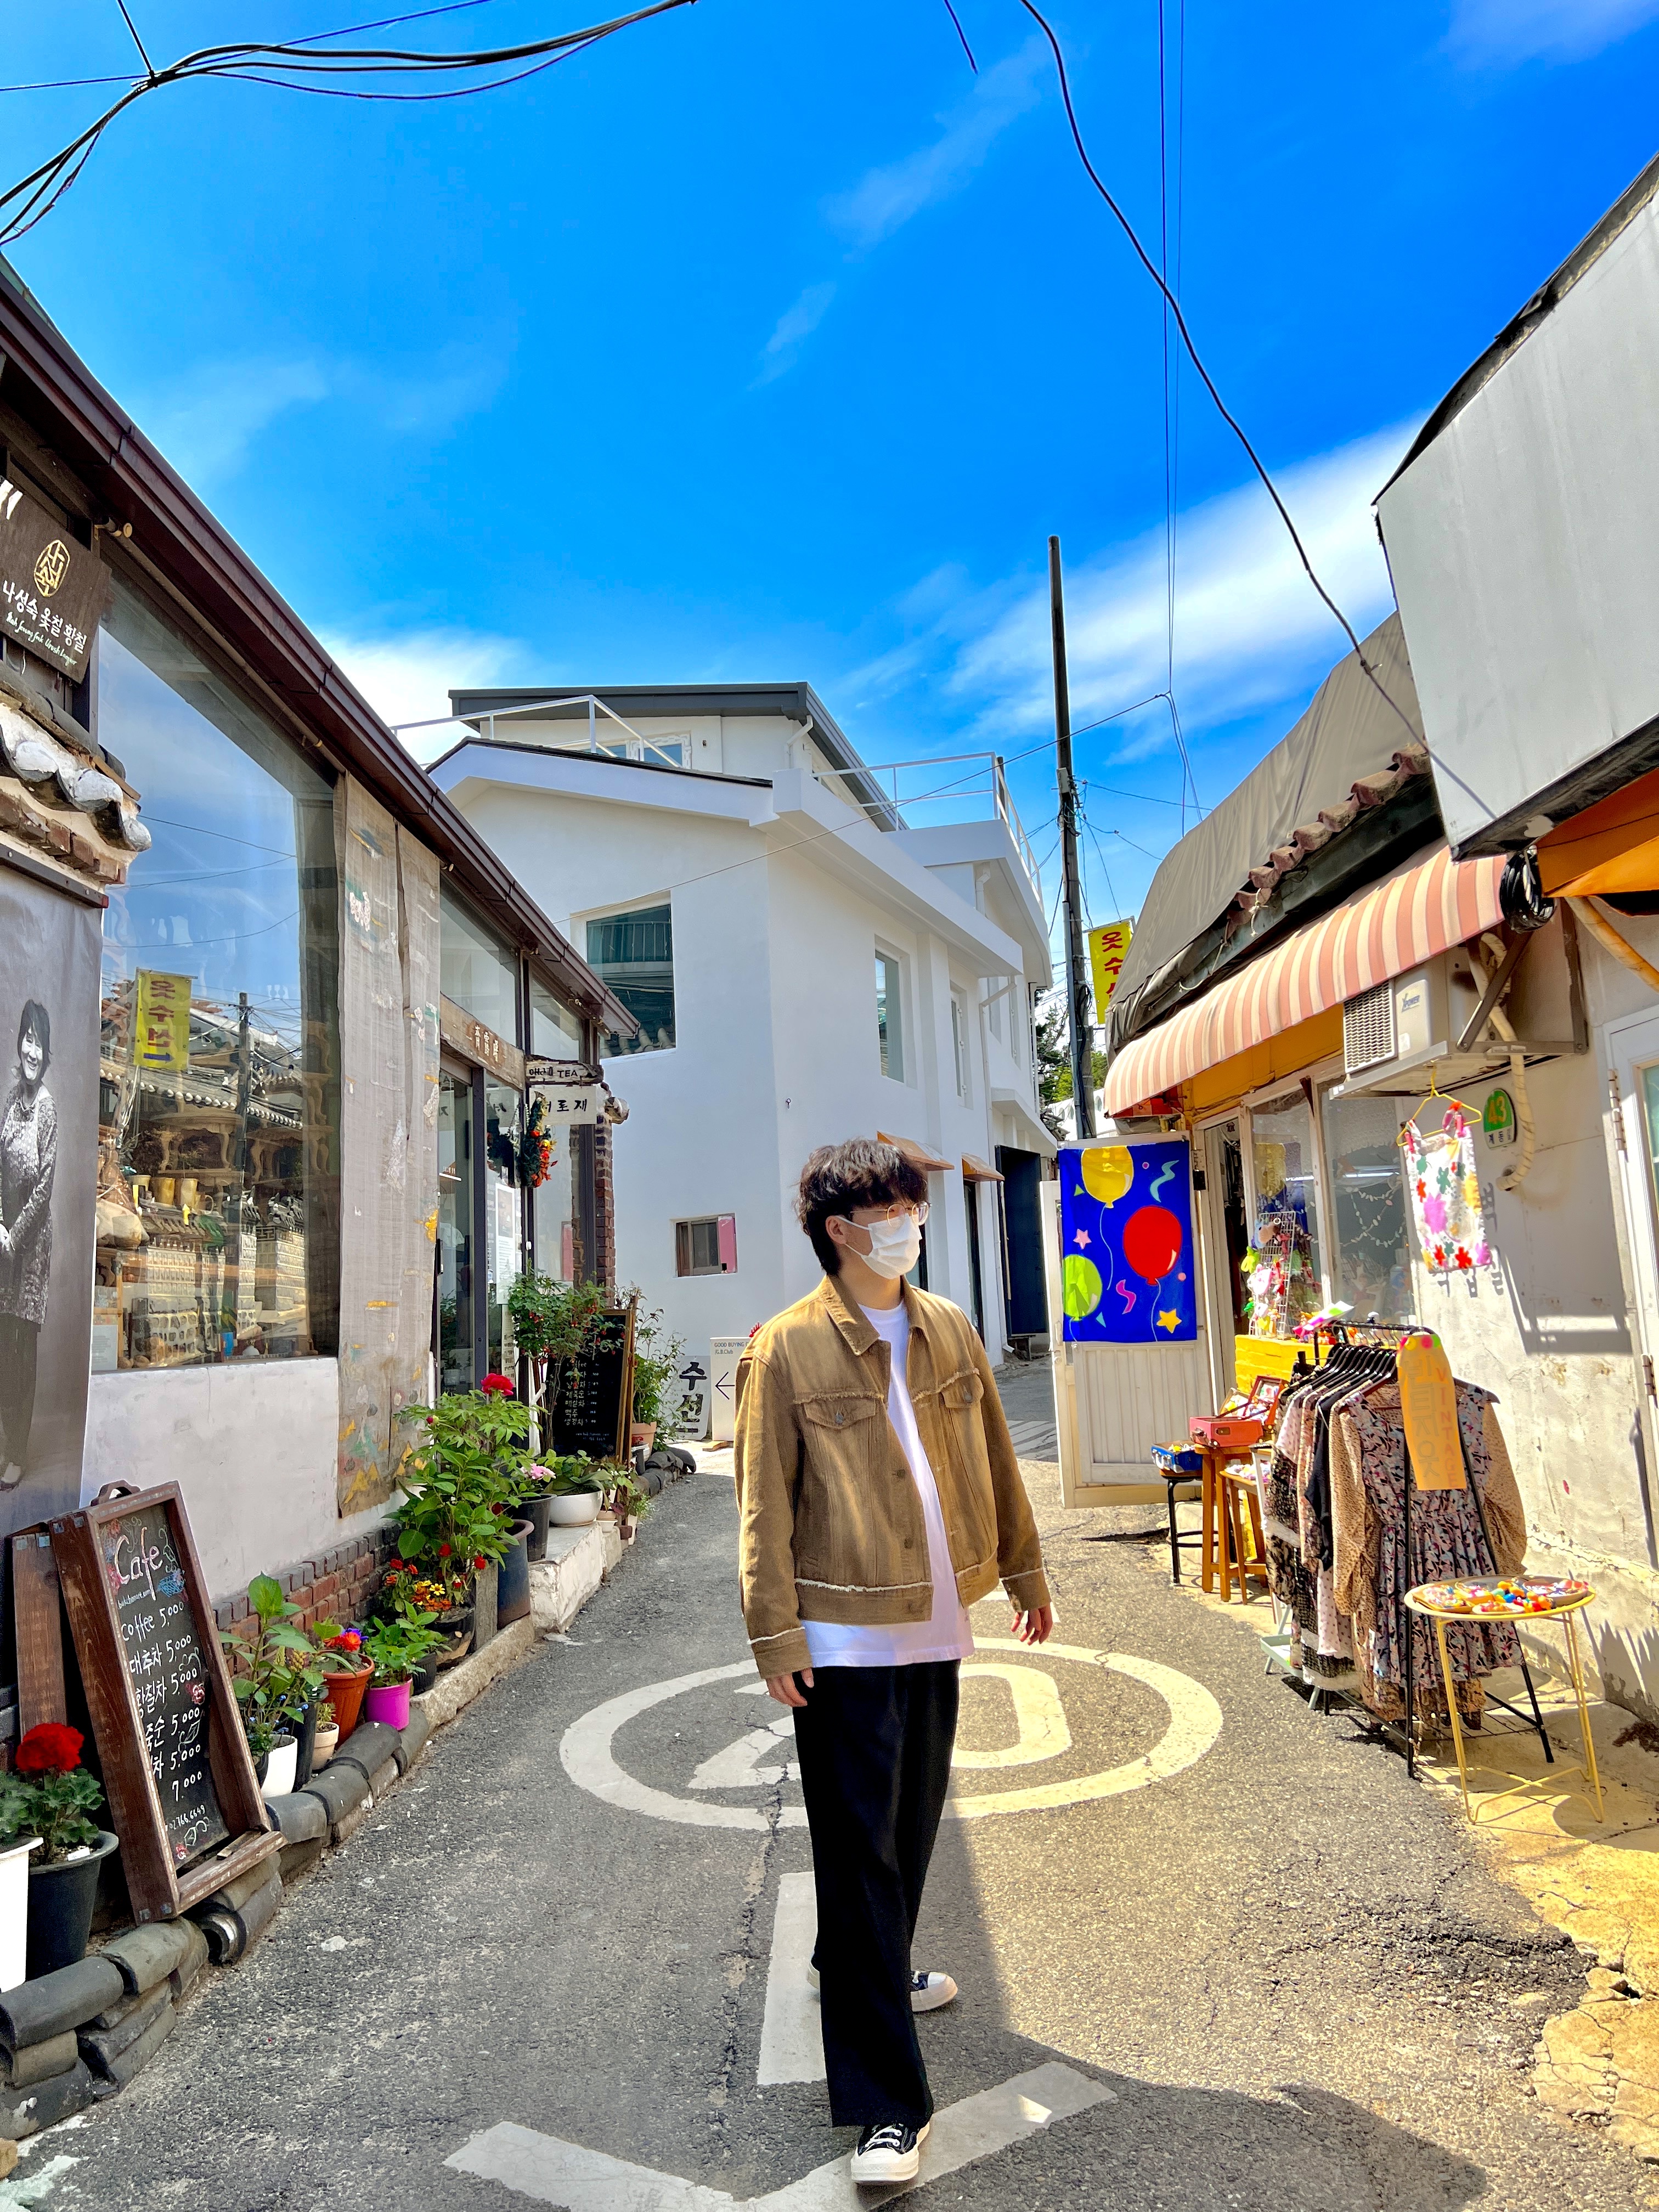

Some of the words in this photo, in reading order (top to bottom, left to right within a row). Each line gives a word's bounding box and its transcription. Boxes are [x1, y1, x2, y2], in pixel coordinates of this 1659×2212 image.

[3, 580, 38, 620] 나성숙
[39, 607, 64, 637] 옻칠
[63, 624, 87, 654] 황칠
[1102, 932, 1124, 999] 옷수
[557, 1069, 578, 1078] TEA
[1488, 1096, 1507, 1124] 43
[1436, 1367, 1458, 1488] VINTAGE
[114, 1526, 163, 1601] Cafe
[129, 1642, 162, 1675] 대추차
[135, 1675, 167, 1719] 황칠차
